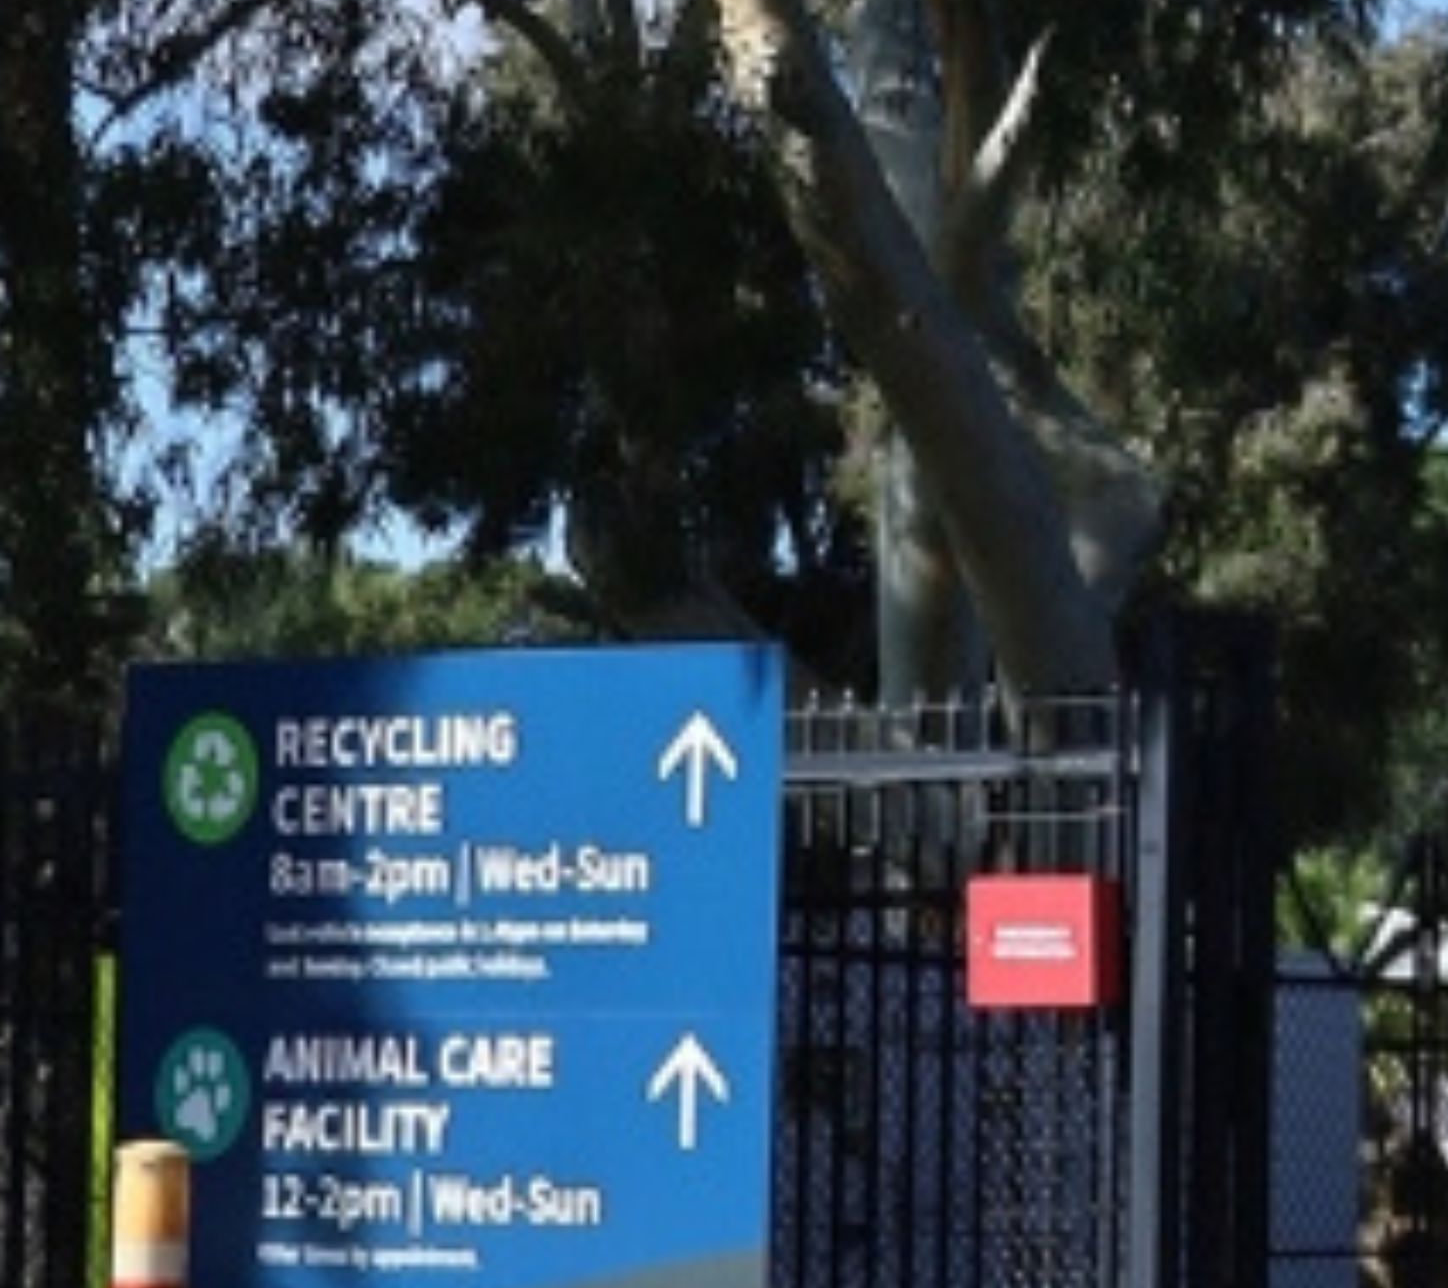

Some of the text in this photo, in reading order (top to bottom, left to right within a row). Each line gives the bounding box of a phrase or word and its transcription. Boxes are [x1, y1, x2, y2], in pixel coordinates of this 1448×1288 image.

[277, 714, 516, 767] RECYCLING
[272, 784, 441, 835] CENTRE
[270, 842, 648, 904] 8am-2pm Wed-Sun
[264, 1035, 553, 1087] ANIMAL CARE
[263, 1103, 450, 1155] FACILITY
[263, 1174, 600, 1230] 12-2pm Wed-Sun
